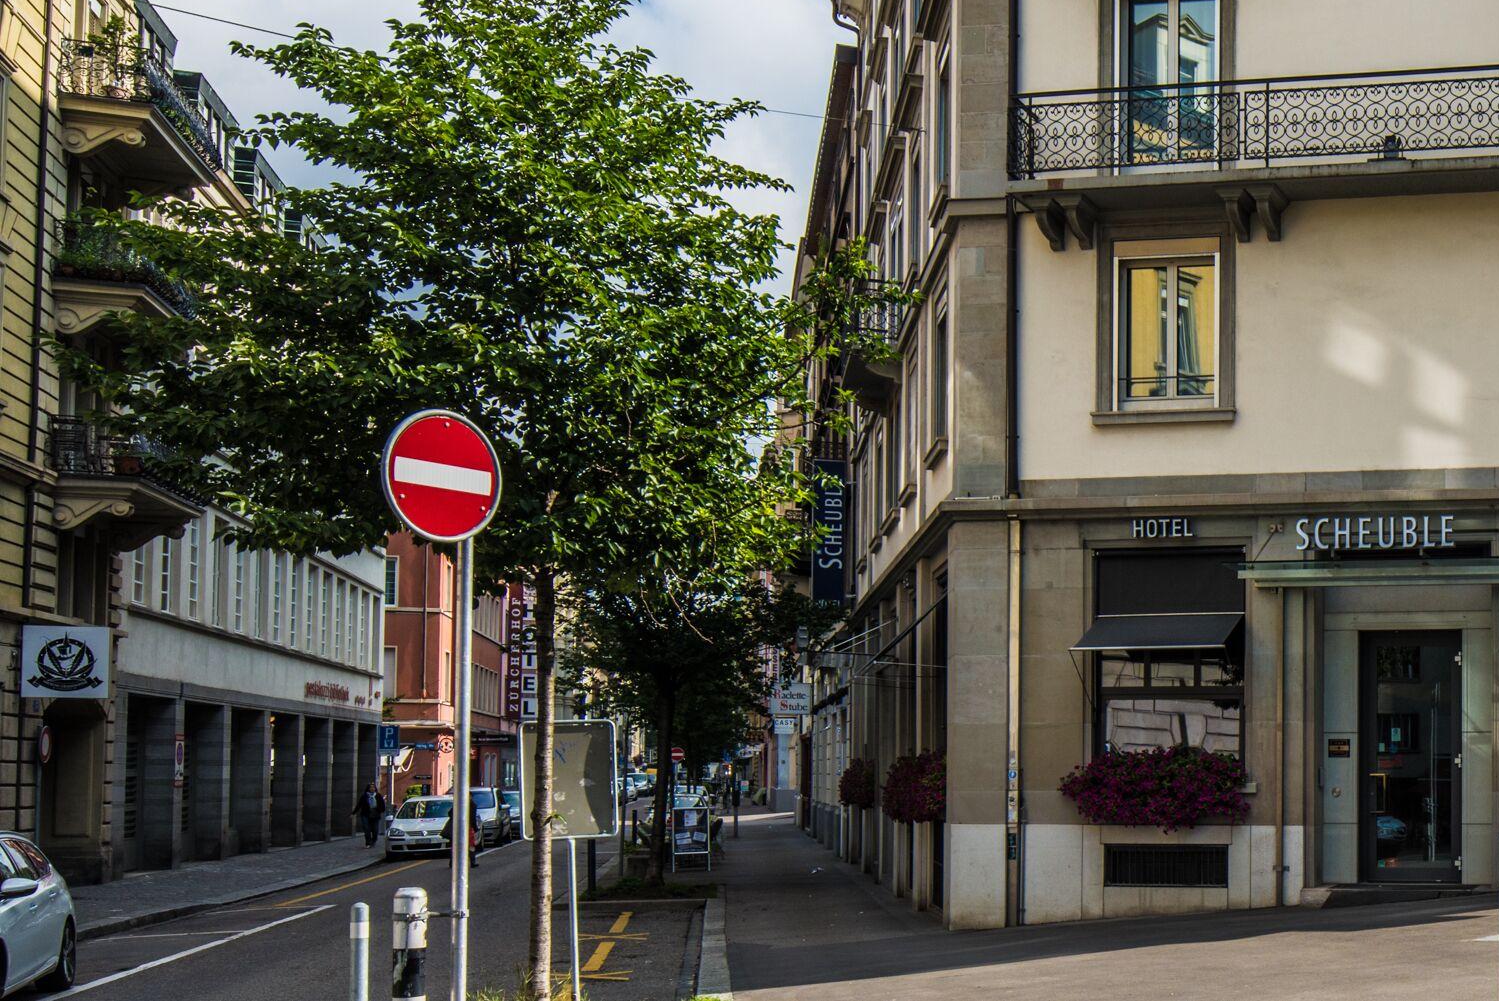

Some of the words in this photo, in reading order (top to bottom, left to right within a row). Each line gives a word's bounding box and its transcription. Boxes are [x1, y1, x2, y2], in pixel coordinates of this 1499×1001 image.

[819, 478, 843, 570] SCHEUBL
[1132, 518, 1193, 538] HOTEL
[1295, 515, 1455, 550] SCHEUBLE
[385, 727, 394, 739] P
